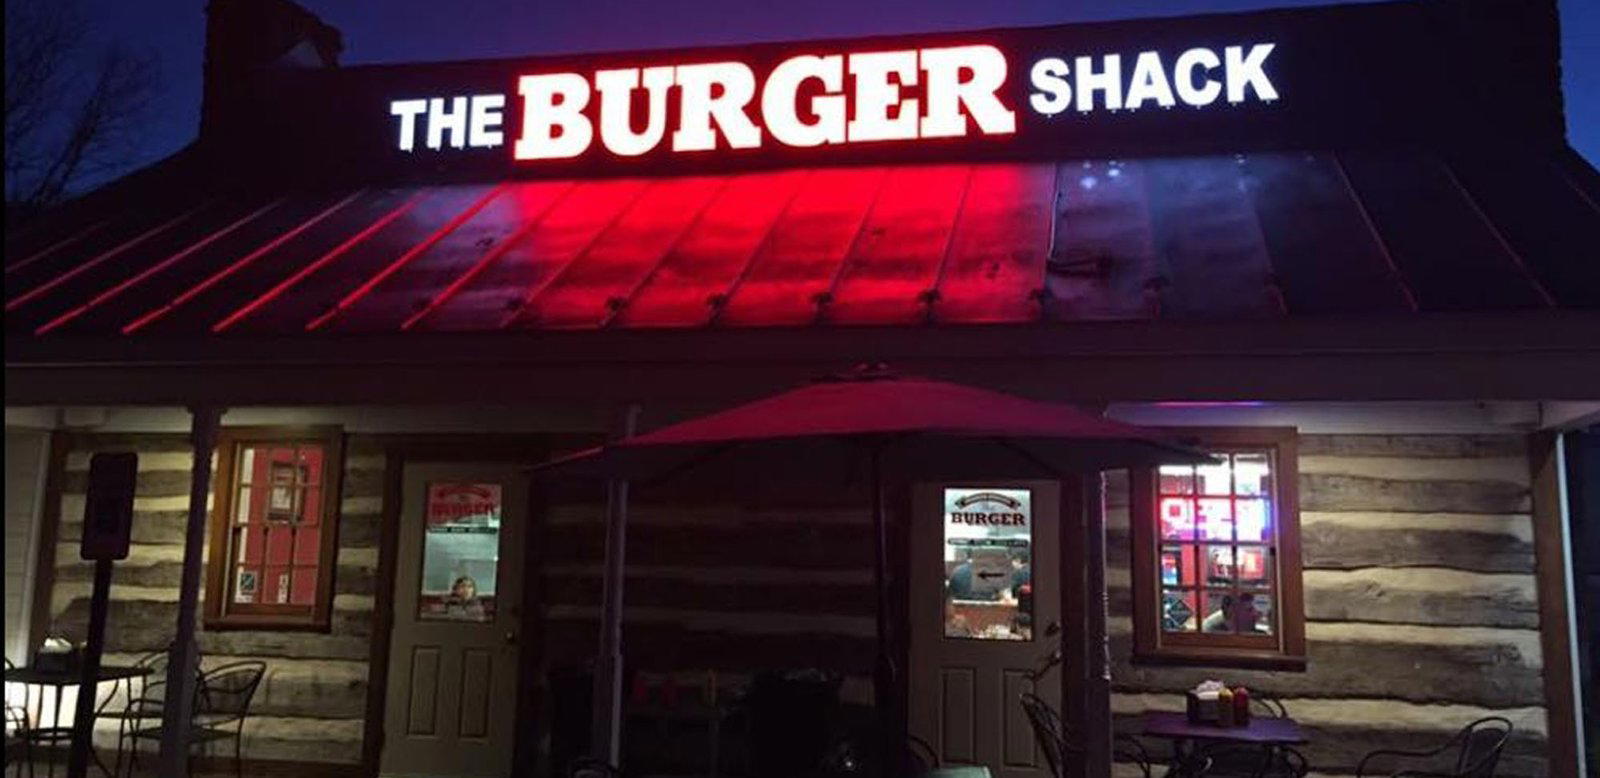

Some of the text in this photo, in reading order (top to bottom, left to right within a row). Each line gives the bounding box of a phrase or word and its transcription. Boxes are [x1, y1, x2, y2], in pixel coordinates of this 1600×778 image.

[391, 44, 1278, 160] THE BURGER SHACK
[951, 511, 1025, 525] BURGER
